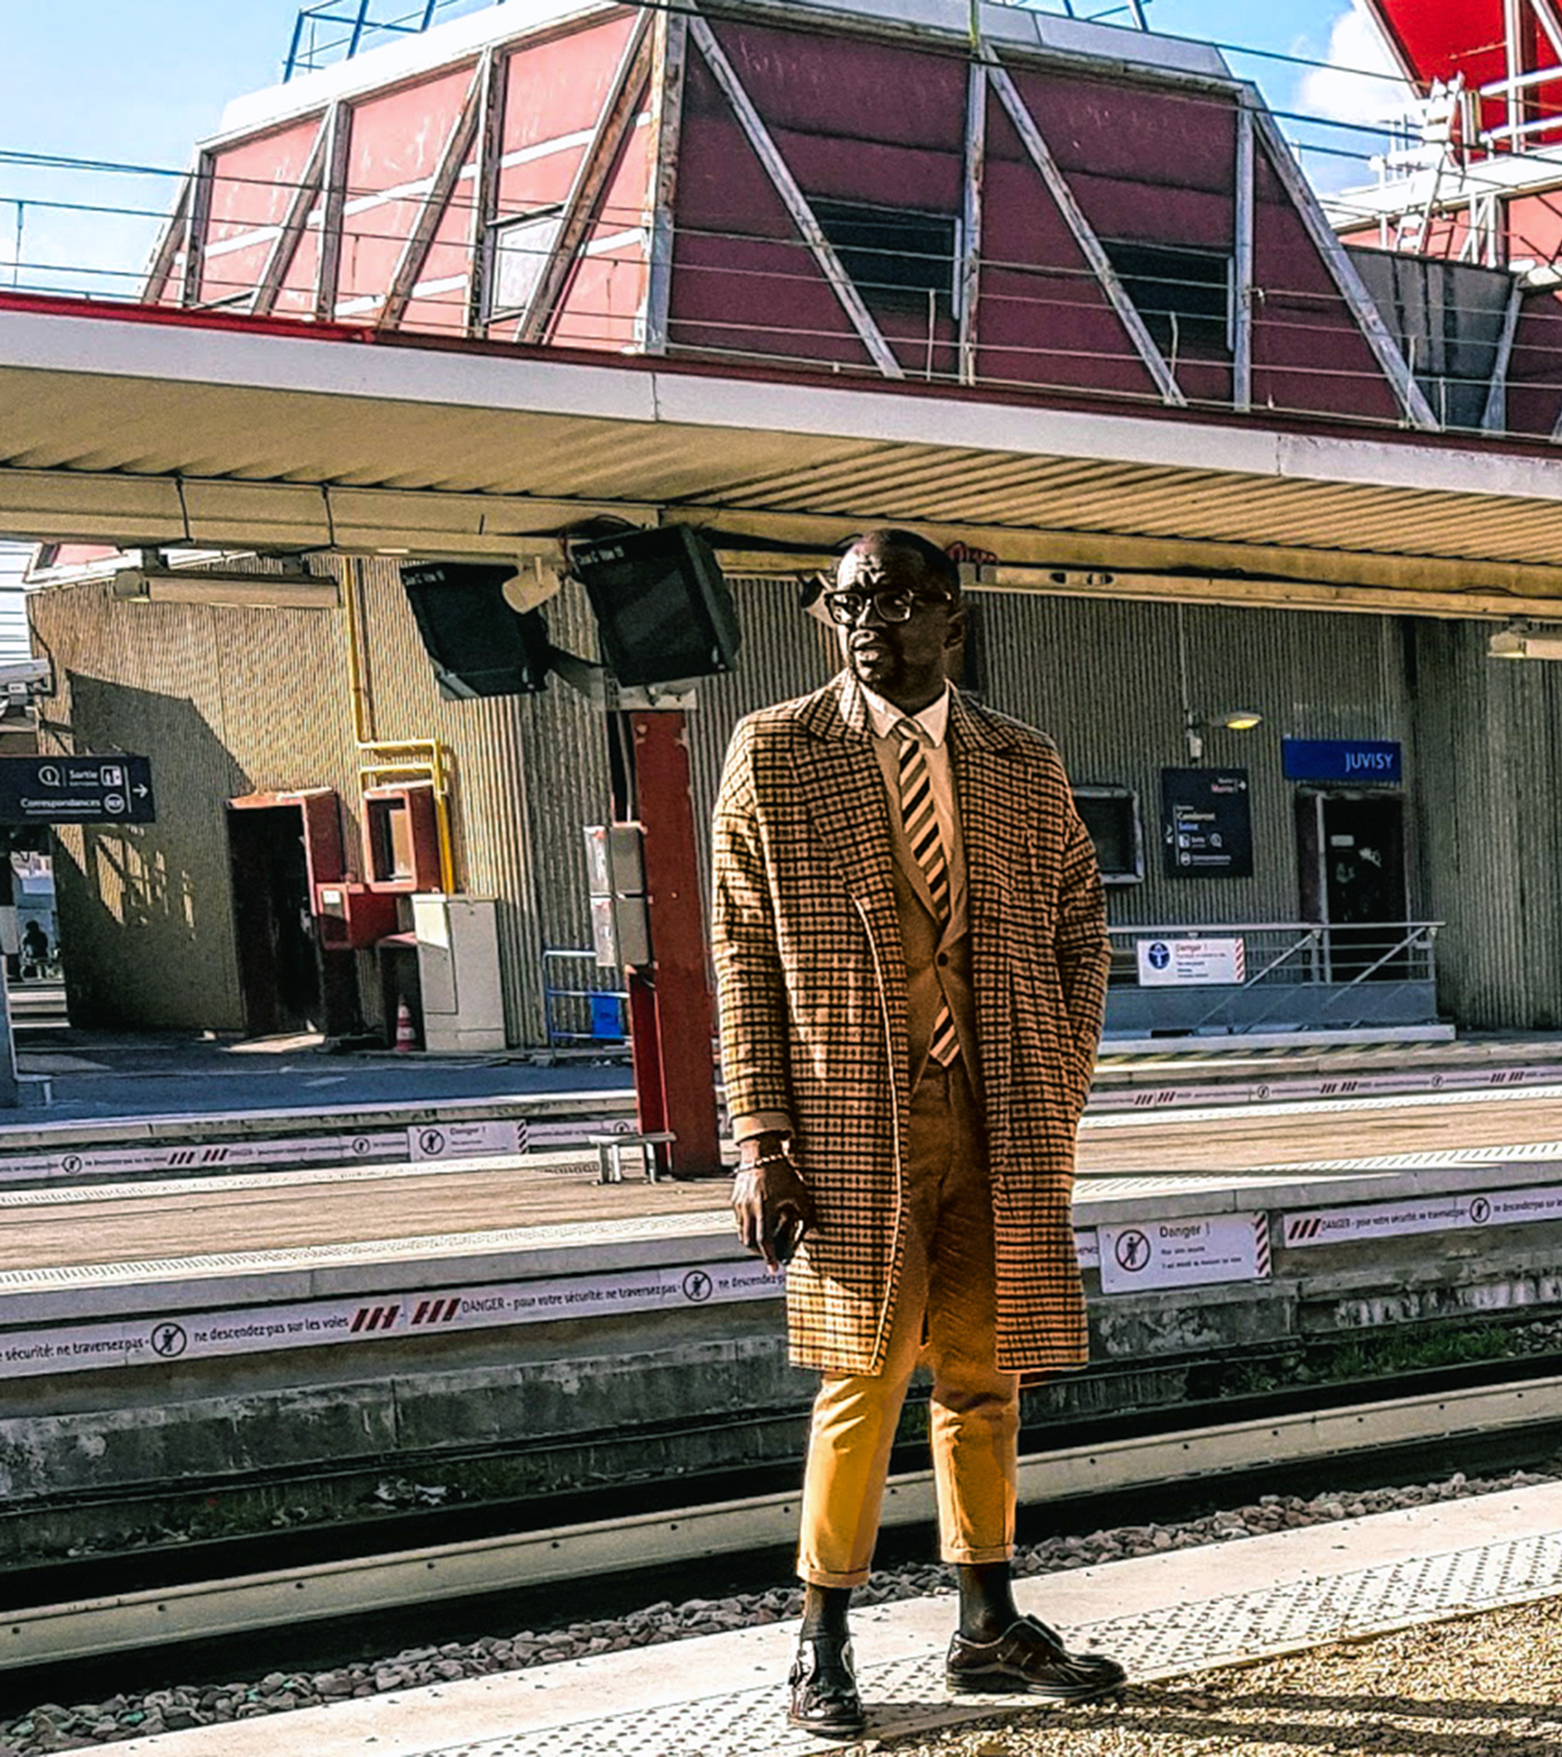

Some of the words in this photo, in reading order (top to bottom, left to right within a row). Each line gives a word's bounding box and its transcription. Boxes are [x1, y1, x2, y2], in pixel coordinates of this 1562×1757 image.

[1345, 752, 1393, 772] JUVISY
[1159, 1224, 1201, 1239] Danger
[462, 1297, 504, 1313] DANGER
[513, 1297, 536, 1311] pour
[194, 1332, 208, 1342] ne
[305, 1317, 320, 1331] les
[322, 1314, 349, 1329] voies
[56, 1344, 71, 1356] ne
